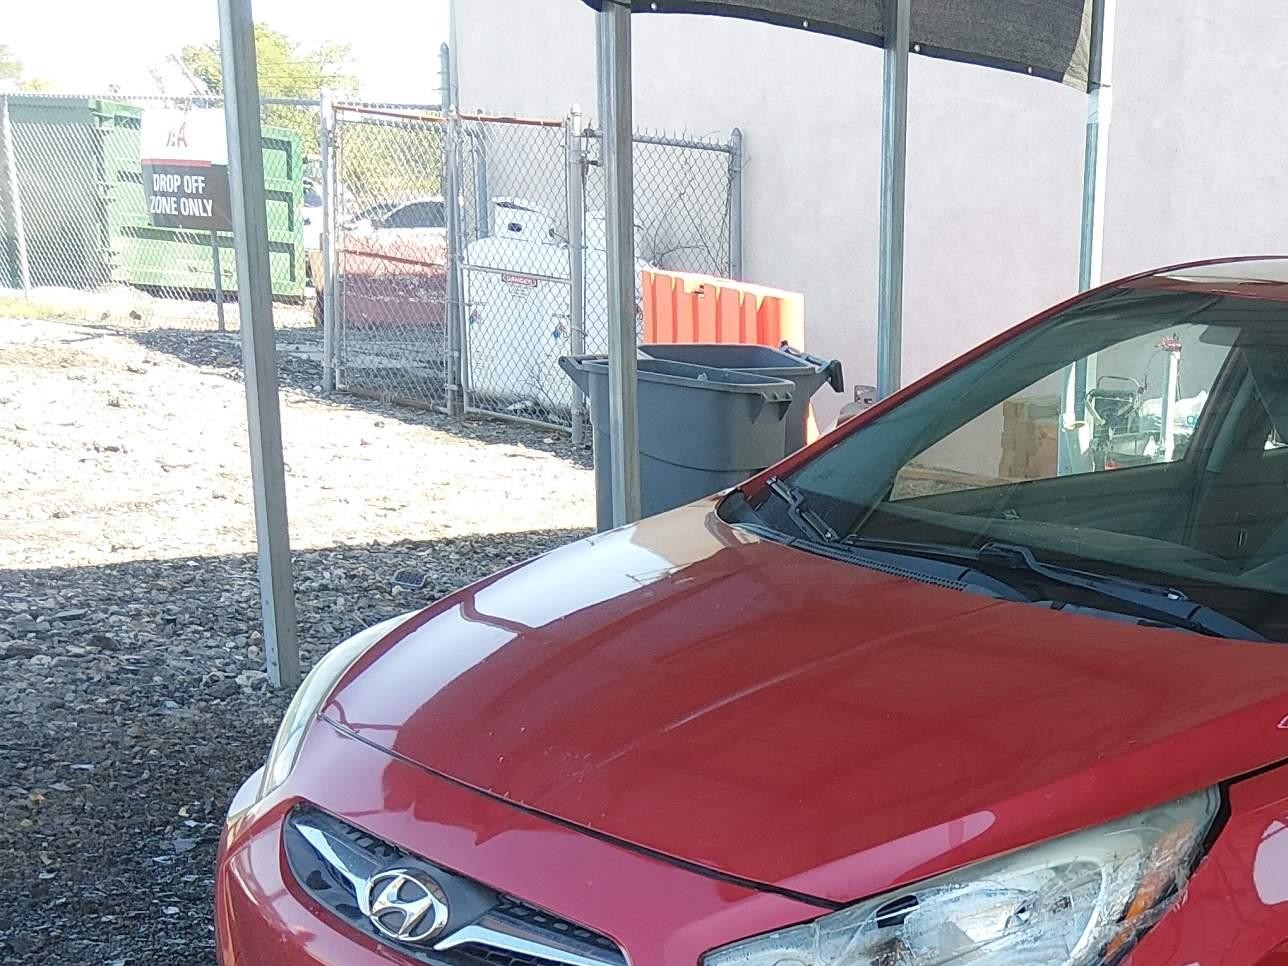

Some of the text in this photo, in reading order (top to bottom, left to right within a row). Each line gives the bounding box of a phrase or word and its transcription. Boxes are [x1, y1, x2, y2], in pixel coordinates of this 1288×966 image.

[152, 173, 206, 194] DROP OFF
[150, 195, 213, 217] ZONE ONLY
